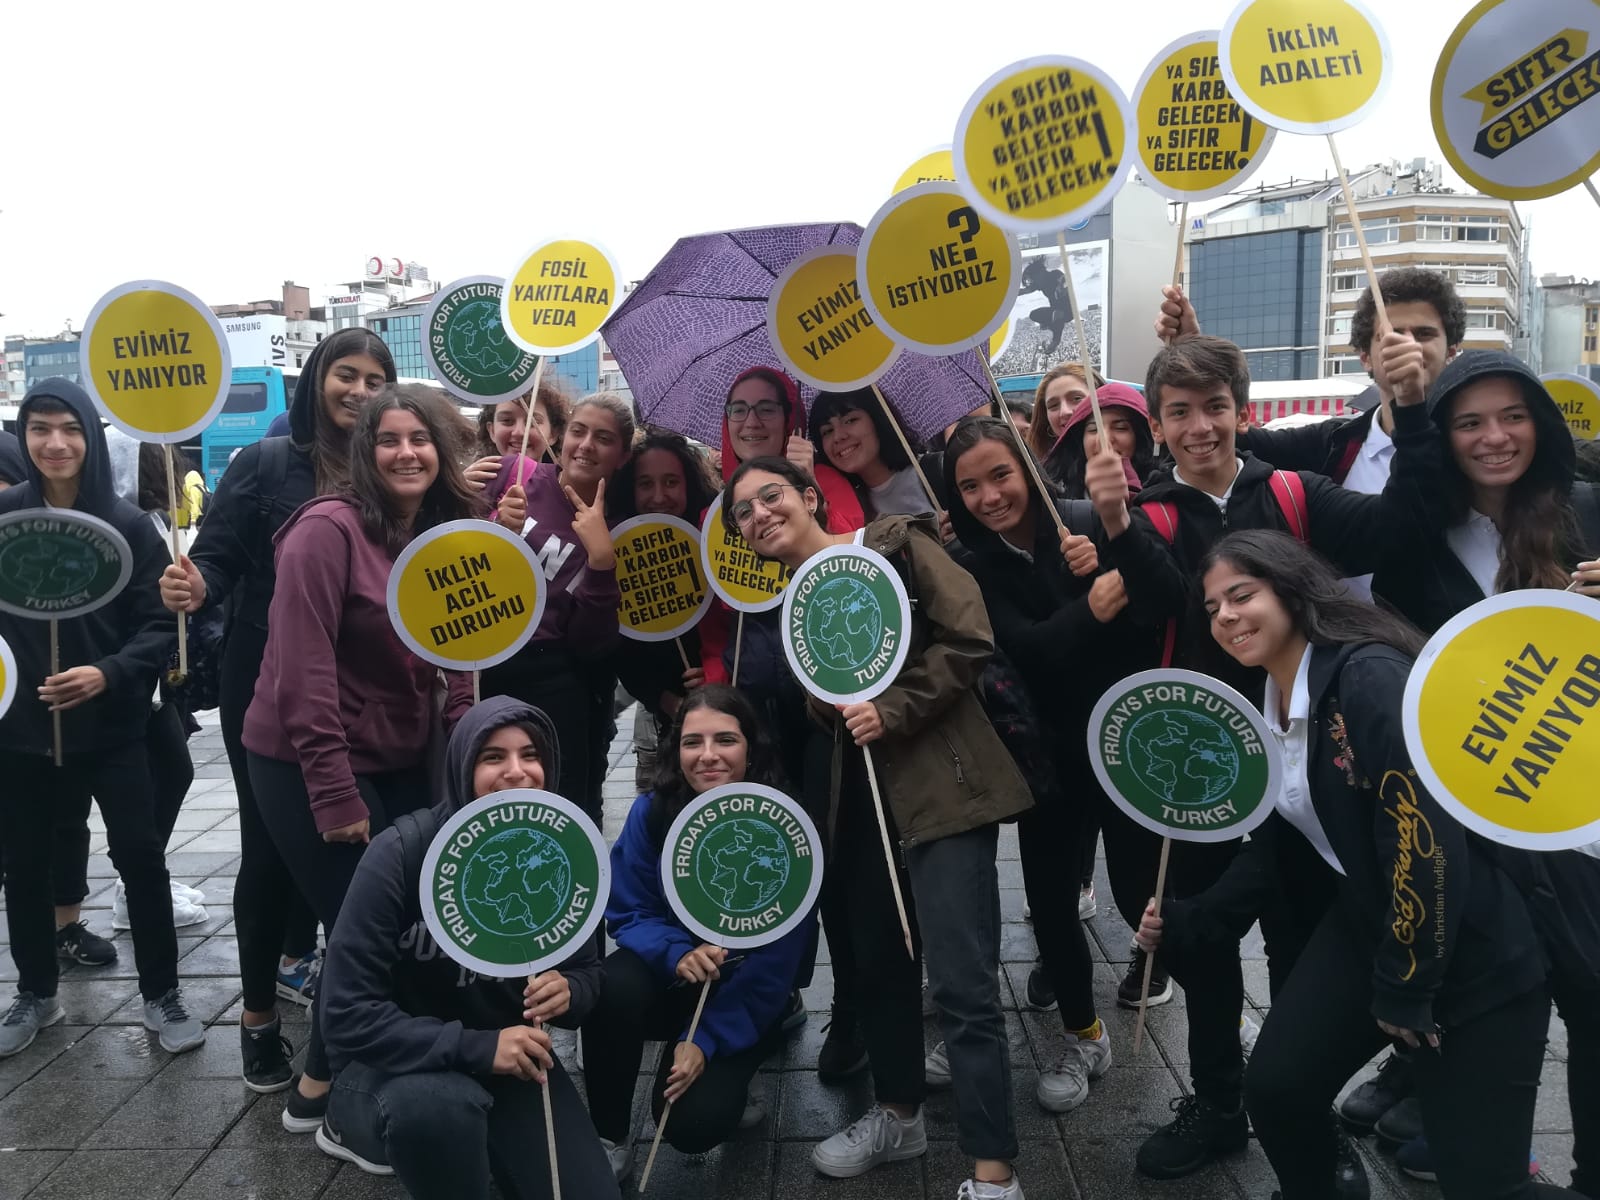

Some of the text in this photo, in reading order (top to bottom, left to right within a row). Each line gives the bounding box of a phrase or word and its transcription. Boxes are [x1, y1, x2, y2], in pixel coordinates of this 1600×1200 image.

[1268, 23, 1339, 53] İKLİM
[1166, 56, 1220, 79] YA SIF
[1260, 50, 1363, 87] ADALETİ
[1486, 37, 1577, 108] SIFIR
[986, 69, 1072, 118] YA SIFIR
[1172, 80, 1234, 102] KARB
[1001, 86, 1097, 138] KARBON
[1158, 103, 1240, 126] GELECEK
[993, 114, 1090, 166] GELECEK
[1146, 128, 1219, 149] YA SIFIR
[988, 145, 1074, 194] YA SIFIR
[540, 257, 588, 278] FOSİL
[886, 260, 997, 309] İSTİYORUZ
[514, 284, 609, 305] YAKITLARA
[797, 280, 861, 333] EVİMİZ
[226, 321, 261, 333] SAMSUNG
[434, 303, 454, 332] FOR
[532, 309, 576, 327] VEDA
[803, 307, 874, 361] YANIYO
[113, 328, 192, 359] EVİMİZ
[107, 363, 207, 391] YANIYOR
[433, 335, 471, 388] FRIDAYS
[614, 528, 675, 558] YA SIFIR
[624, 541, 691, 573] KARBON
[714, 549, 726, 562] YA
[425, 552, 492, 592] İKLİM
[619, 560, 688, 593] GELECEK
[25, 588, 92, 609] TURKEY
[444, 580, 496, 614] ACİL
[634, 581, 678, 606] SIFIR
[430, 595, 525, 647] DURUMU
[793, 558, 880, 676] FRIDAYS FOR FUTURE
[854, 627, 895, 684] TURKEY
[1461, 643, 1559, 765] EVİMİZ
[1104, 686, 1263, 766] FRIDAYS FOR FUTURE
[1161, 799, 1238, 825] TURKEY
[676, 798, 810, 878] FRIDAYS FOR FUTURE
[439, 806, 570, 946] FRIDAYS FOR FUTURE
[1433, 845, 1447, 891] Audigier
[533, 883, 590, 950] TURKEY
[718, 900, 784, 931] TURKEY
[1434, 893, 1445, 943] Christian
